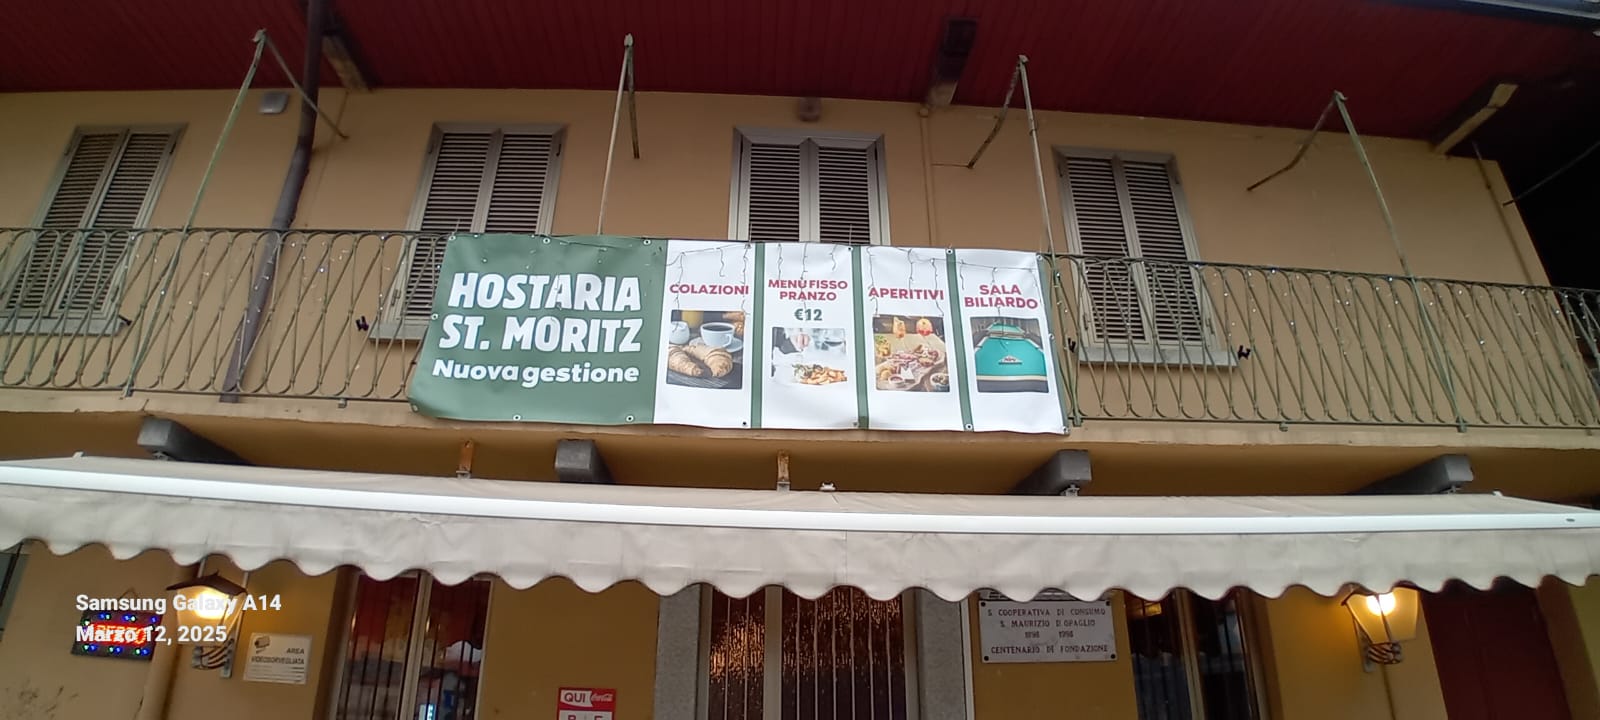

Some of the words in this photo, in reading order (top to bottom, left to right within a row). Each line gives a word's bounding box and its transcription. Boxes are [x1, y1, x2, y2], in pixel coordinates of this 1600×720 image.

[669, 284, 749, 295] COLAZIONI
[809, 280, 848, 289] FISSO
[979, 284, 1022, 295] SALA
[448, 272, 641, 311] HOSTARIA
[779, 291, 837, 301] PRANZO
[868, 287, 944, 301] APERITIVI
[964, 297, 1038, 309] BILIARDO
[794, 308, 823, 321] €12
[439, 315, 490, 350] ST.
[502, 316, 643, 352] MORITZ
[432, 359, 519, 382] Nuova
[521, 362, 640, 388] gestione
[998, 608, 1050, 616] COOPERATIVA
[1057, 608, 1065, 616] DI
[1070, 608, 1106, 616] CONSUMO
[991, 646, 1040, 654] CENTENARIO
[1046, 645, 1054, 653] DI
[1060, 644, 1108, 653] FONDAZIONE
[564, 692, 587, 703] QUI
